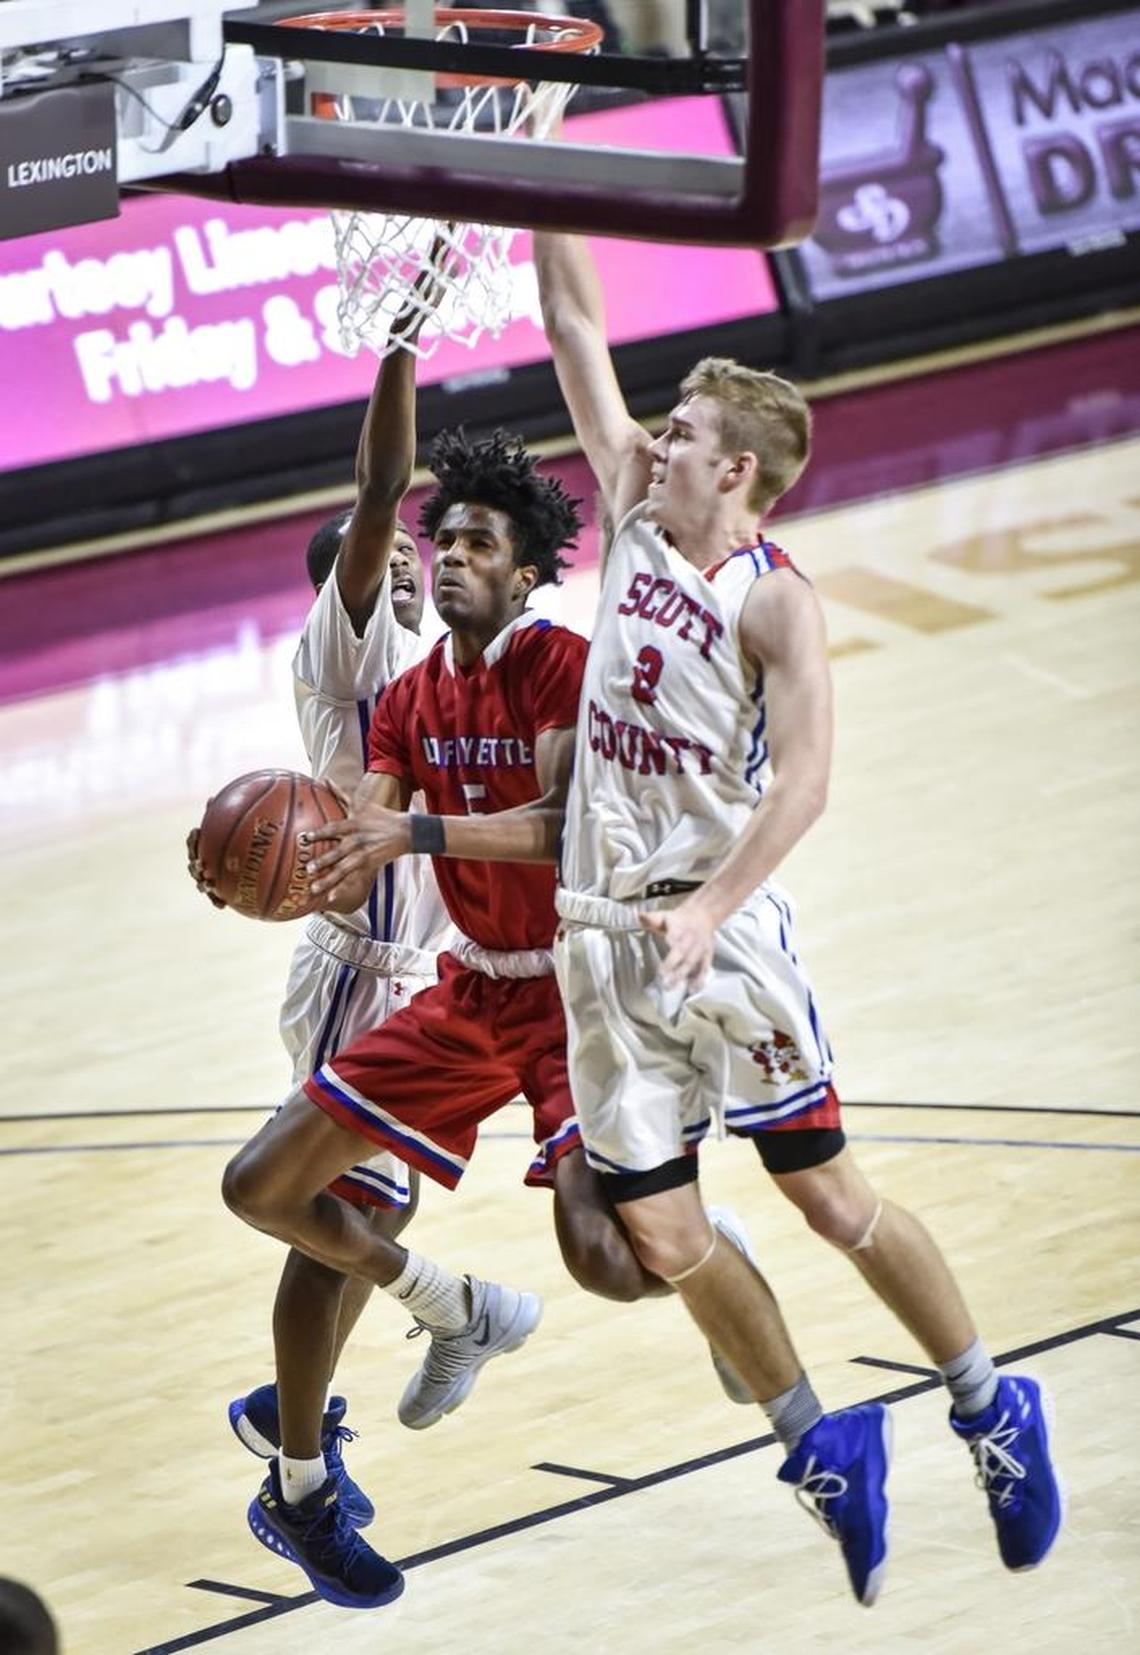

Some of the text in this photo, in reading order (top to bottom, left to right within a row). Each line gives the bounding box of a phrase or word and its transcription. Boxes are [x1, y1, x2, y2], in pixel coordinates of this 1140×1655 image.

[8, 148, 112, 188] LEXINGTON
[74, 316, 257, 402] Friday
[264, 295, 320, 365] &
[618, 572, 724, 662] SCOTT
[631, 644, 664, 705] 2
[588, 699, 713, 776] COUNTY
